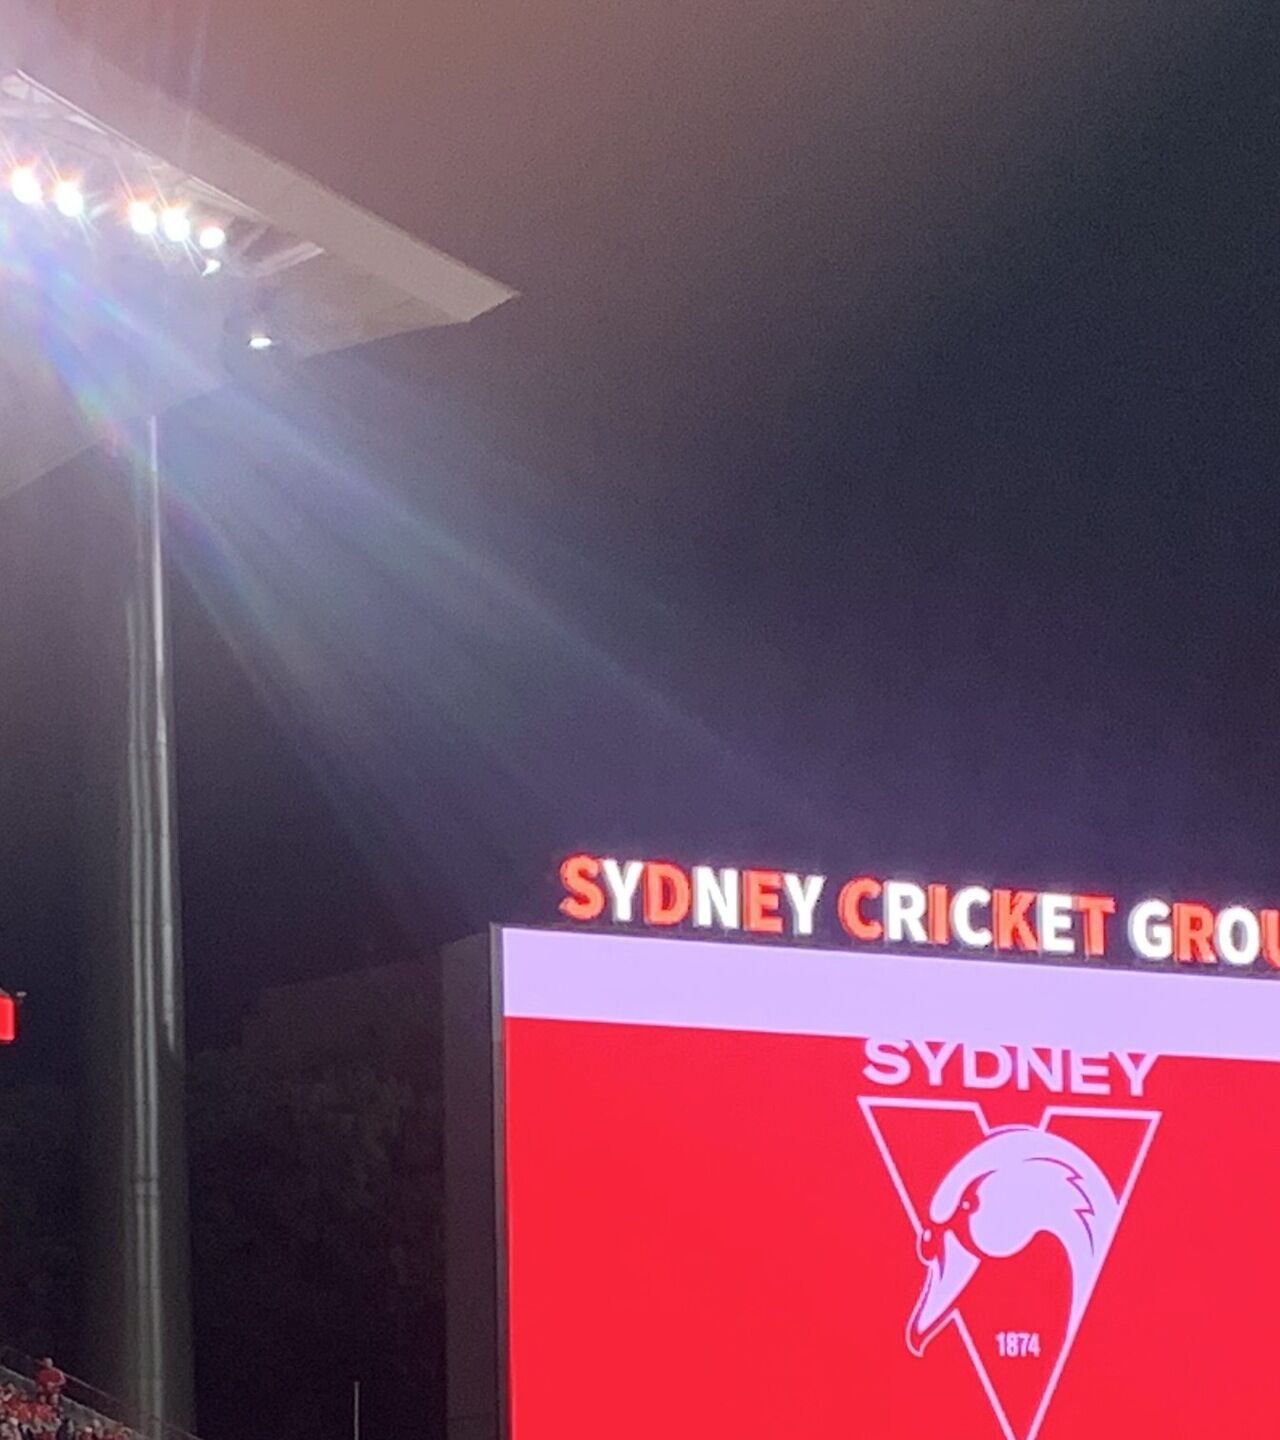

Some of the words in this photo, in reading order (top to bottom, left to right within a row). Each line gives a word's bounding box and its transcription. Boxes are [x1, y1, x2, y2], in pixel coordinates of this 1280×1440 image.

[558, 852, 827, 936] SYDNEY
[836, 874, 1117, 956] CRICKET
[862, 1037, 1160, 1097] SYDNEY
[995, 1331, 1041, 1358] 1874
